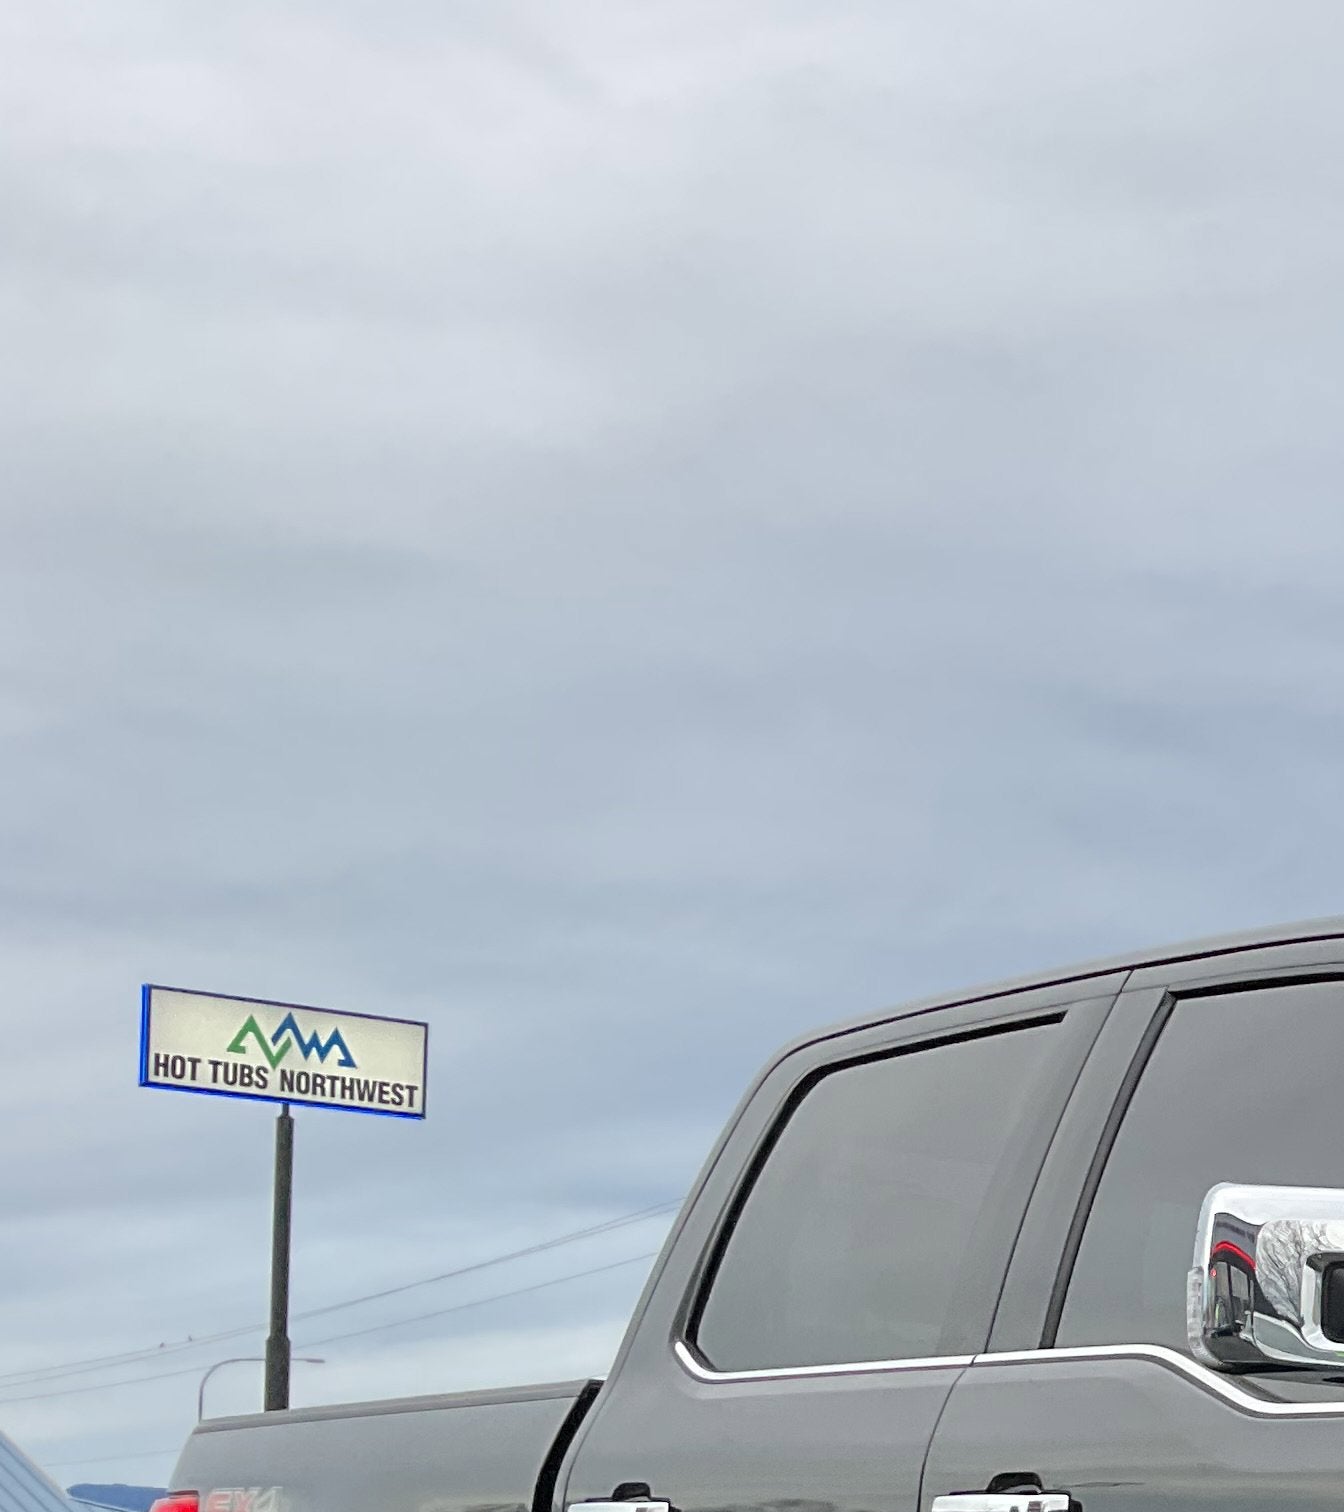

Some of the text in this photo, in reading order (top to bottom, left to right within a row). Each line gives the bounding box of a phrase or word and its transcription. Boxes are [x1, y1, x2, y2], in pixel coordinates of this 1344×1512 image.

[153, 1052, 419, 1108] HOT TUBS NORTHWEST
